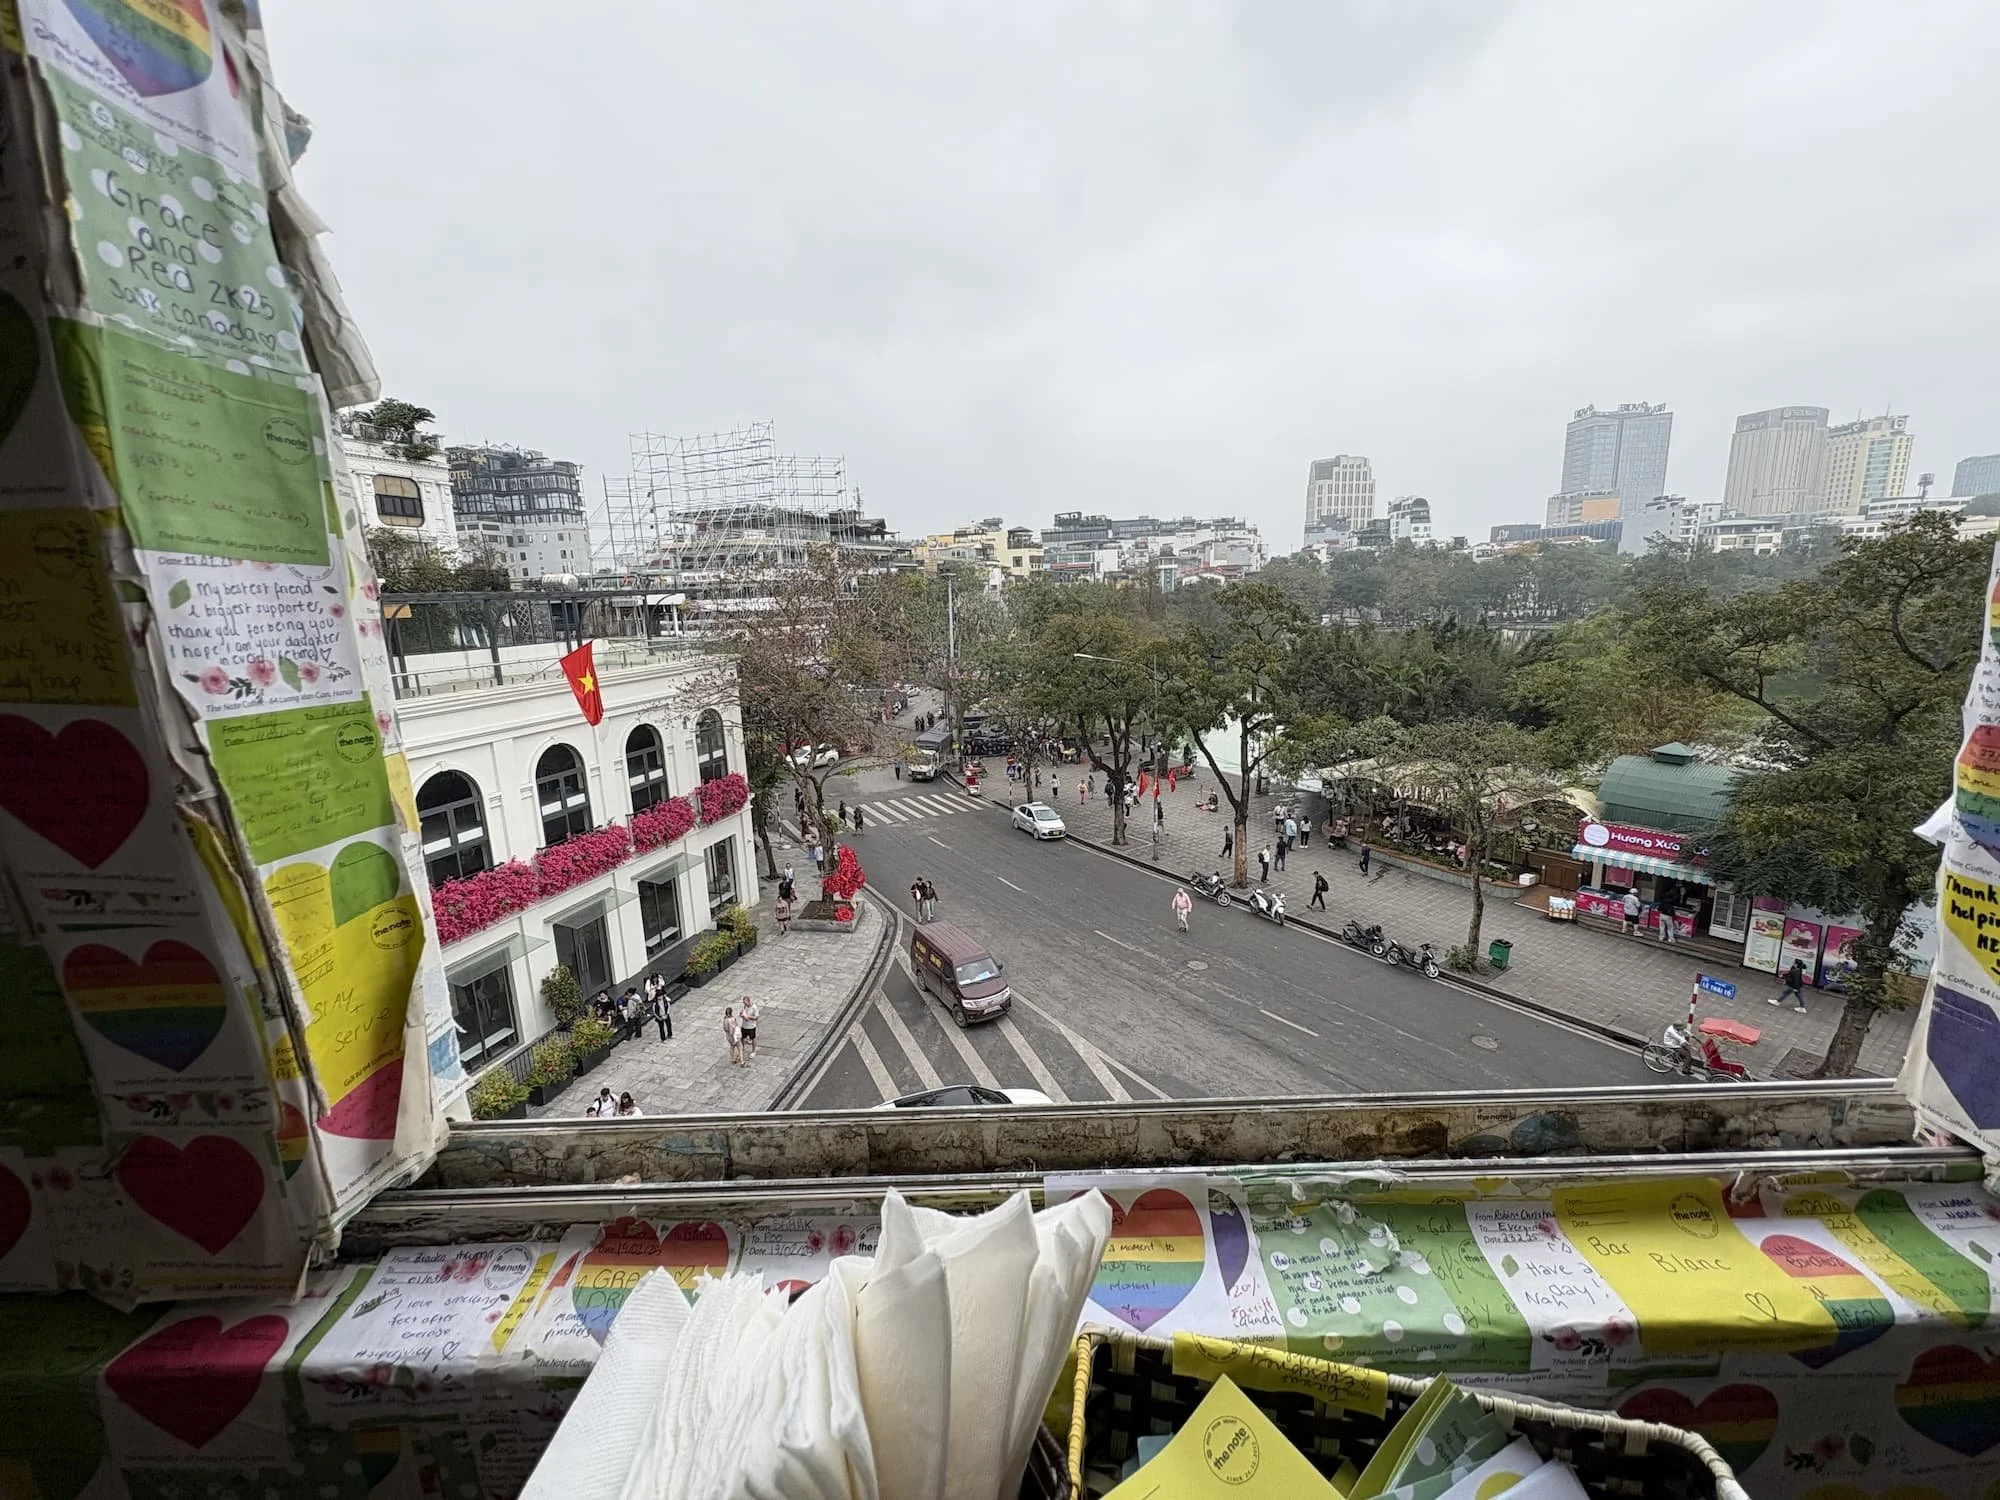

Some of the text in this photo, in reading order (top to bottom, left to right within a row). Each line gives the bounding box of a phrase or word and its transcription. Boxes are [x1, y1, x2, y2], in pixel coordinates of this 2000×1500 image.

[107, 169, 223, 248] Grace
[138, 227, 196, 266] and
[197, 583, 220, 604] My
[168, 626, 213, 639] thank
[215, 627, 237, 646] you
[182, 644, 219, 661] hope
[206, 704, 222, 713] The
[224, 702, 241, 711] Note
[301, 692, 314, 701] Van
[354, 735, 375, 746] note
[1946, 874, 1999, 905] Thank
[389, 918, 412, 934] note
[1475, 1212, 1494, 1221] From
[1690, 1210, 1712, 1220] note
[1479, 1224, 1489, 1233] To
[1587, 1236, 1731, 1274] Bar Blanc
[507, 1263, 527, 1273] note
[1527, 1261, 1574, 1278] Have
[1227, 1427, 1247, 1454] note
